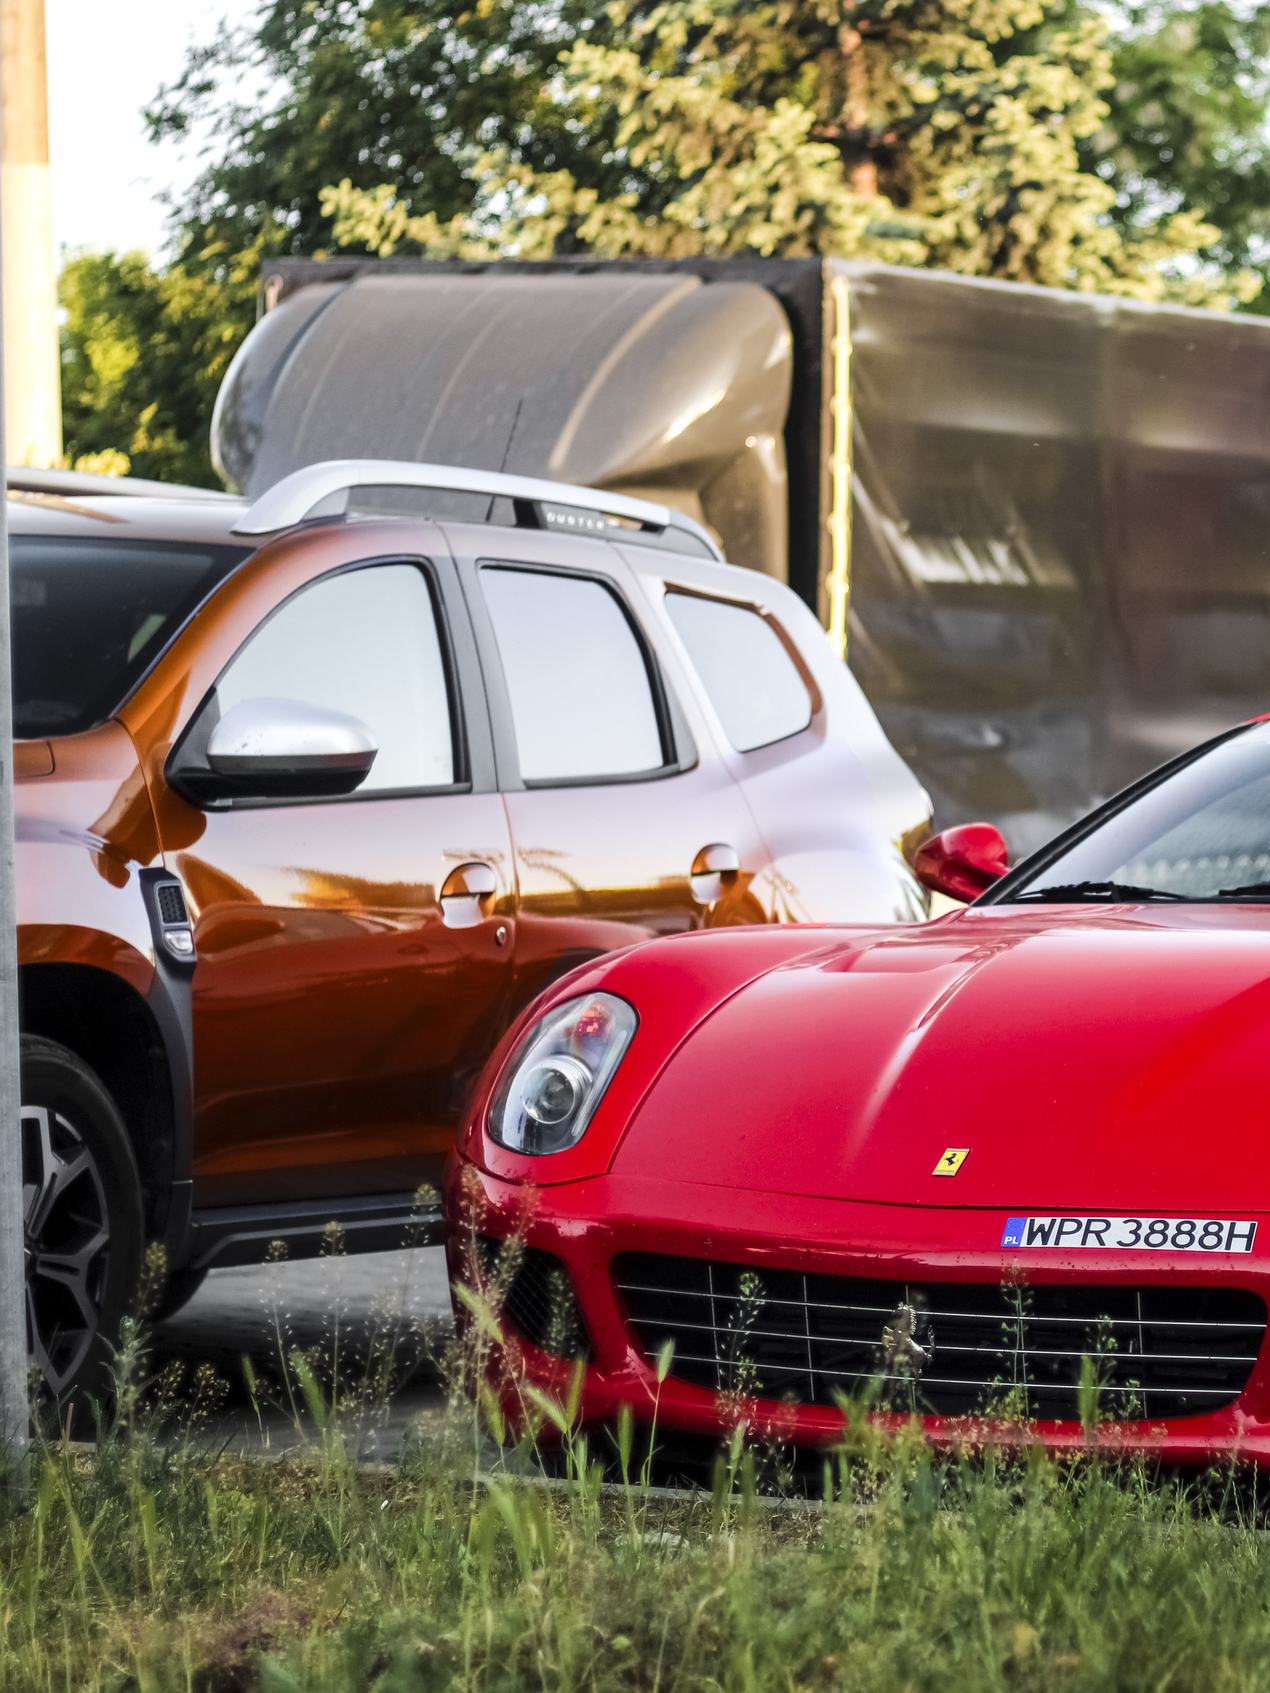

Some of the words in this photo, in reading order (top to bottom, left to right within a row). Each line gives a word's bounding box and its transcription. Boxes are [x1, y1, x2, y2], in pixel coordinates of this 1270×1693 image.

[546, 511, 605, 531] DUSTER
[1004, 1236, 1019, 1245] PL
[1026, 1218, 1112, 1246] WPR
[1116, 1218, 1256, 1251] 3888H
